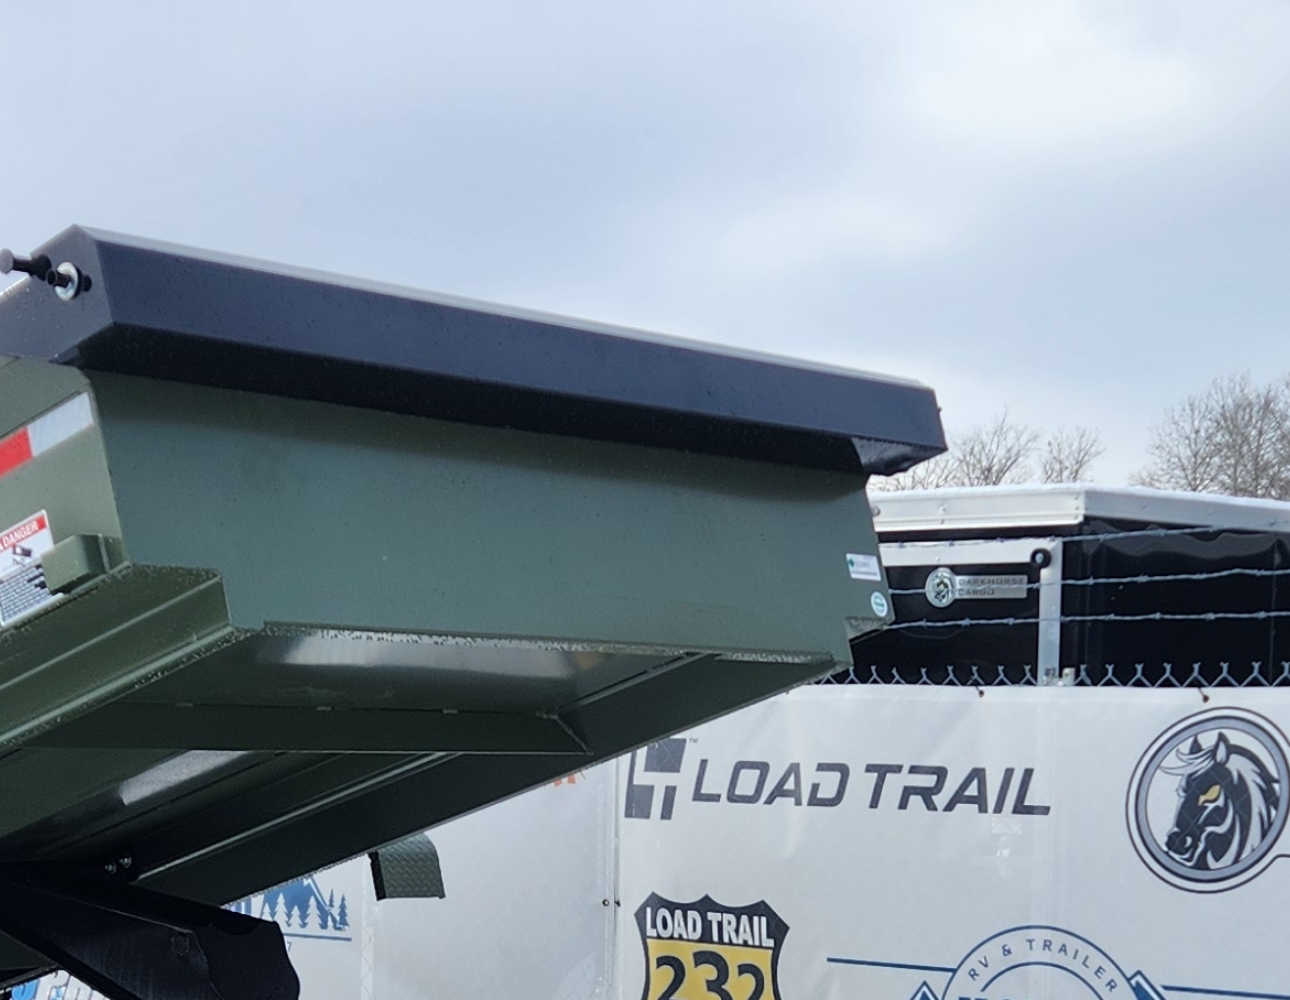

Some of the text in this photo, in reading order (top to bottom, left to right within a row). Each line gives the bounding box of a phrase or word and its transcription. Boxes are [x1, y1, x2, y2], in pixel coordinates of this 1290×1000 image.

[2, 520, 39, 548] DANGER
[691, 758, 1051, 817] LOAD TRAIL
[645, 906, 775, 948] LOAD TRAIL
[967, 938, 1118, 993] RV & TRAILER
